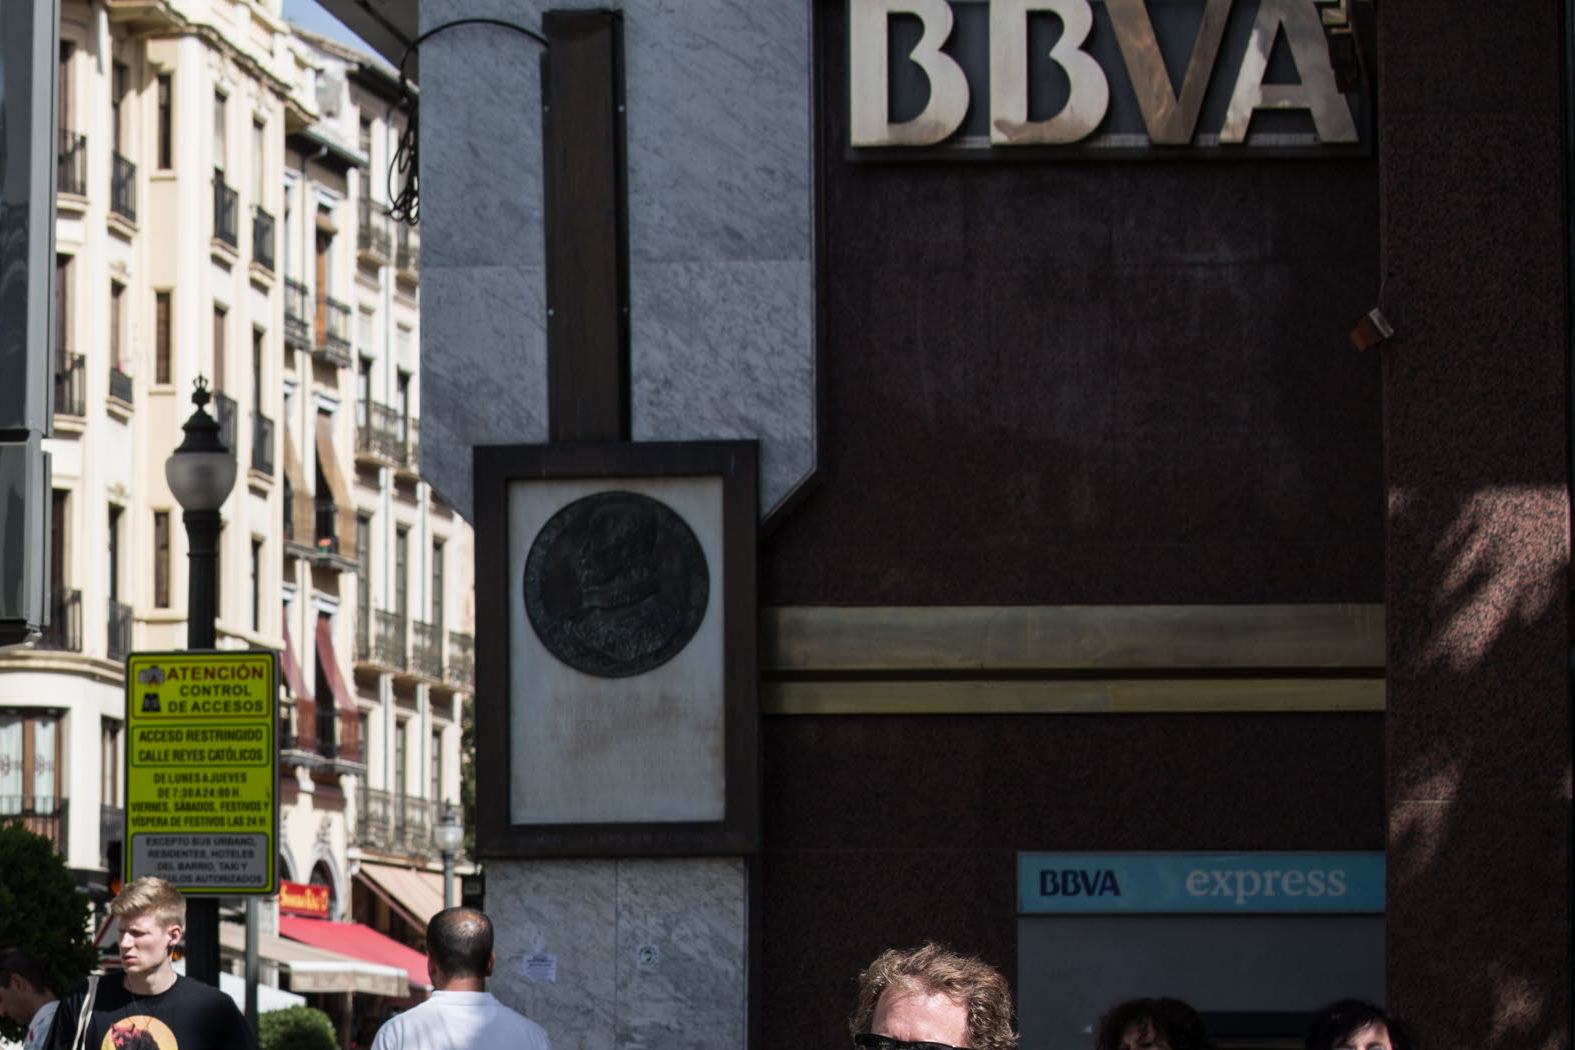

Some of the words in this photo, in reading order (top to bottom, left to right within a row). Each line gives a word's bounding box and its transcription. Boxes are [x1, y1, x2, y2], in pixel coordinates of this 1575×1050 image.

[851, 0, 1358, 147] BBVA
[167, 663, 264, 681] ATENCIÓN
[179, 684, 252, 697] CONTROL
[168, 701, 187, 713] DE
[191, 701, 264, 713] ACCESOS
[139, 730, 183, 743] ACCESO
[186, 729, 263, 743] RESTRINGIDO
[139, 750, 170, 763] CALLE
[175, 750, 205, 763] REYES
[208, 747, 263, 762] CATÓLICOS
[153, 773, 165, 784] DE
[168, 773, 200, 784] LUNES
[202, 773, 209, 784] A
[209, 772, 247, 784] JUEVES
[157, 788, 170, 799] DE
[220, 801, 261, 812] FESTIVOS
[262, 801, 269, 811] Y
[170, 817, 181, 827] DE
[184, 816, 225, 827] FESTIVOS
[228, 816, 244, 826] LAS
[246, 816, 257, 826] 24
[146, 837, 189, 846] EXCEPTO
[192, 837, 211, 846] BUS
[210, 849, 254, 858] HOTELES
[157, 862, 174, 871] DEL
[219, 862, 239, 871] TAXI
[241, 862, 248, 871] Y
[195, 874, 262, 883] AUTORIZADOS
[1039, 869, 1121, 897] BBVA
[1185, 868, 1347, 905] express
